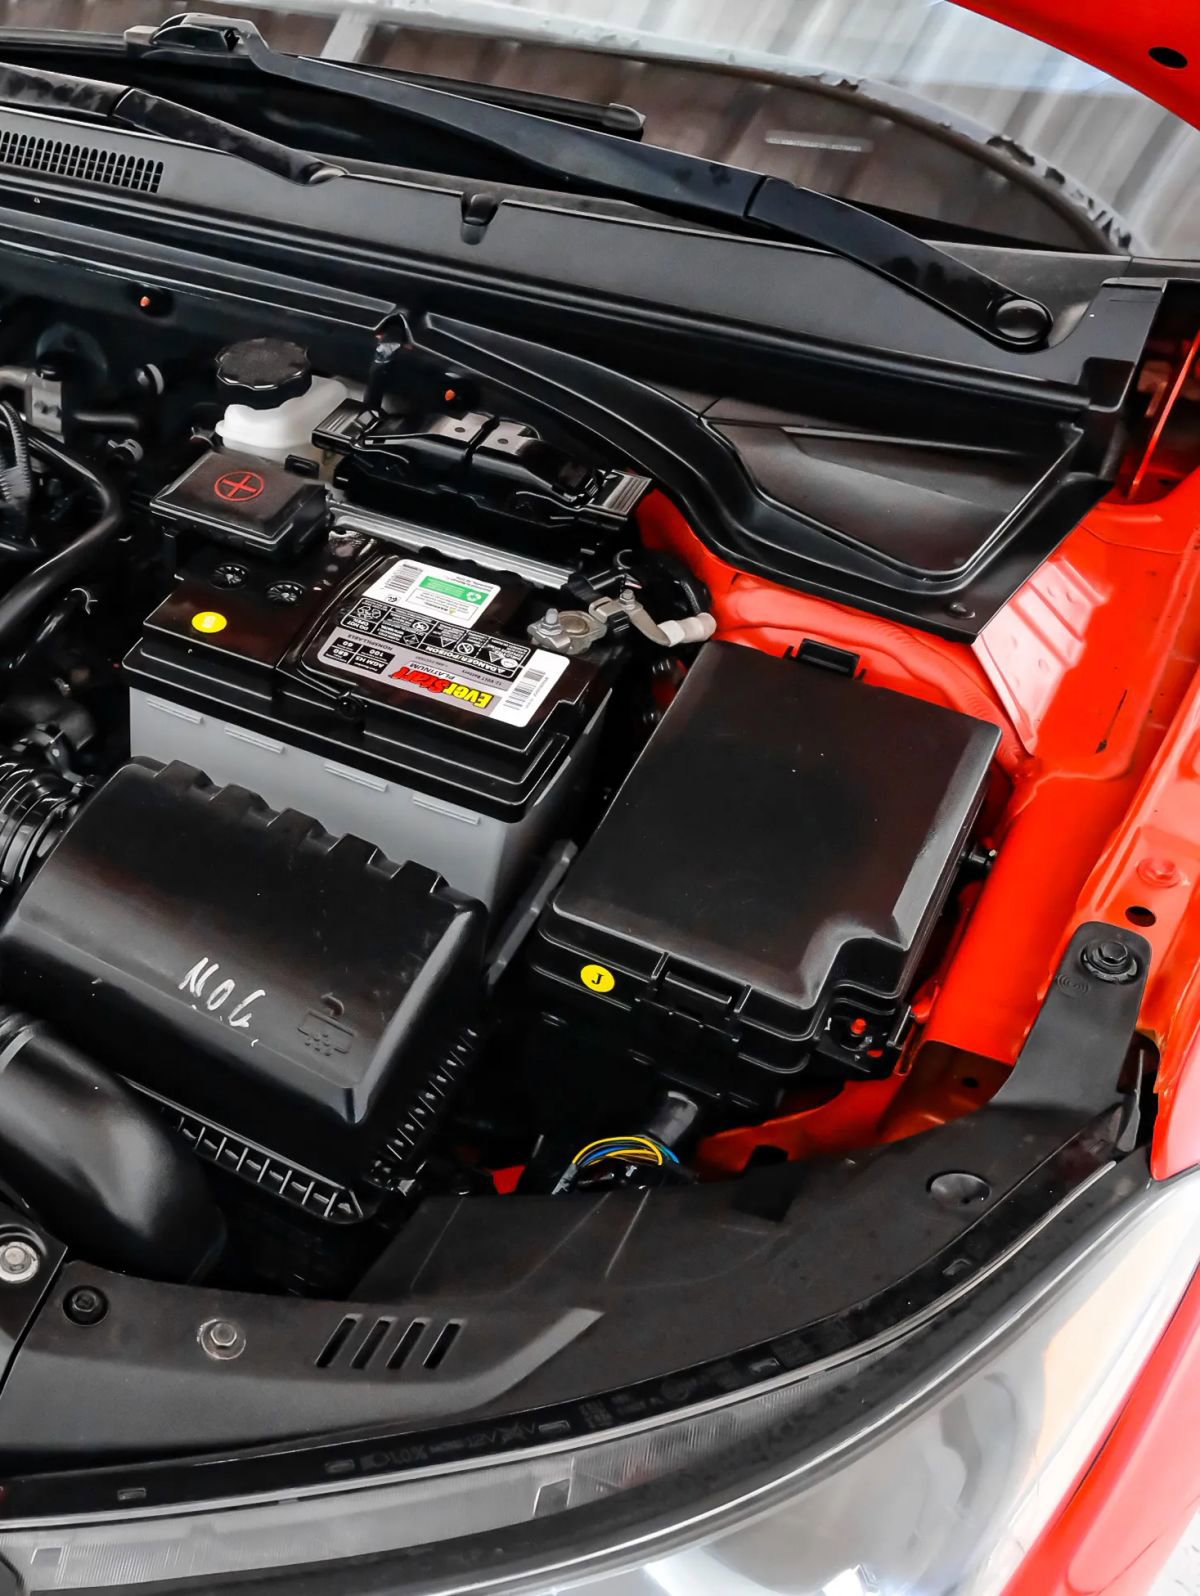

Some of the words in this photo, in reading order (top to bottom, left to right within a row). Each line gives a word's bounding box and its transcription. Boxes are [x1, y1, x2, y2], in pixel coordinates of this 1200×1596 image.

[346, 620, 360, 628] NOT
[369, 649, 384, 657] 100
[366, 658, 385, 668] AGM
[409, 662, 456, 680] PLATINUM
[390, 666, 495, 709] EverStart
[591, 973, 605, 985] J
